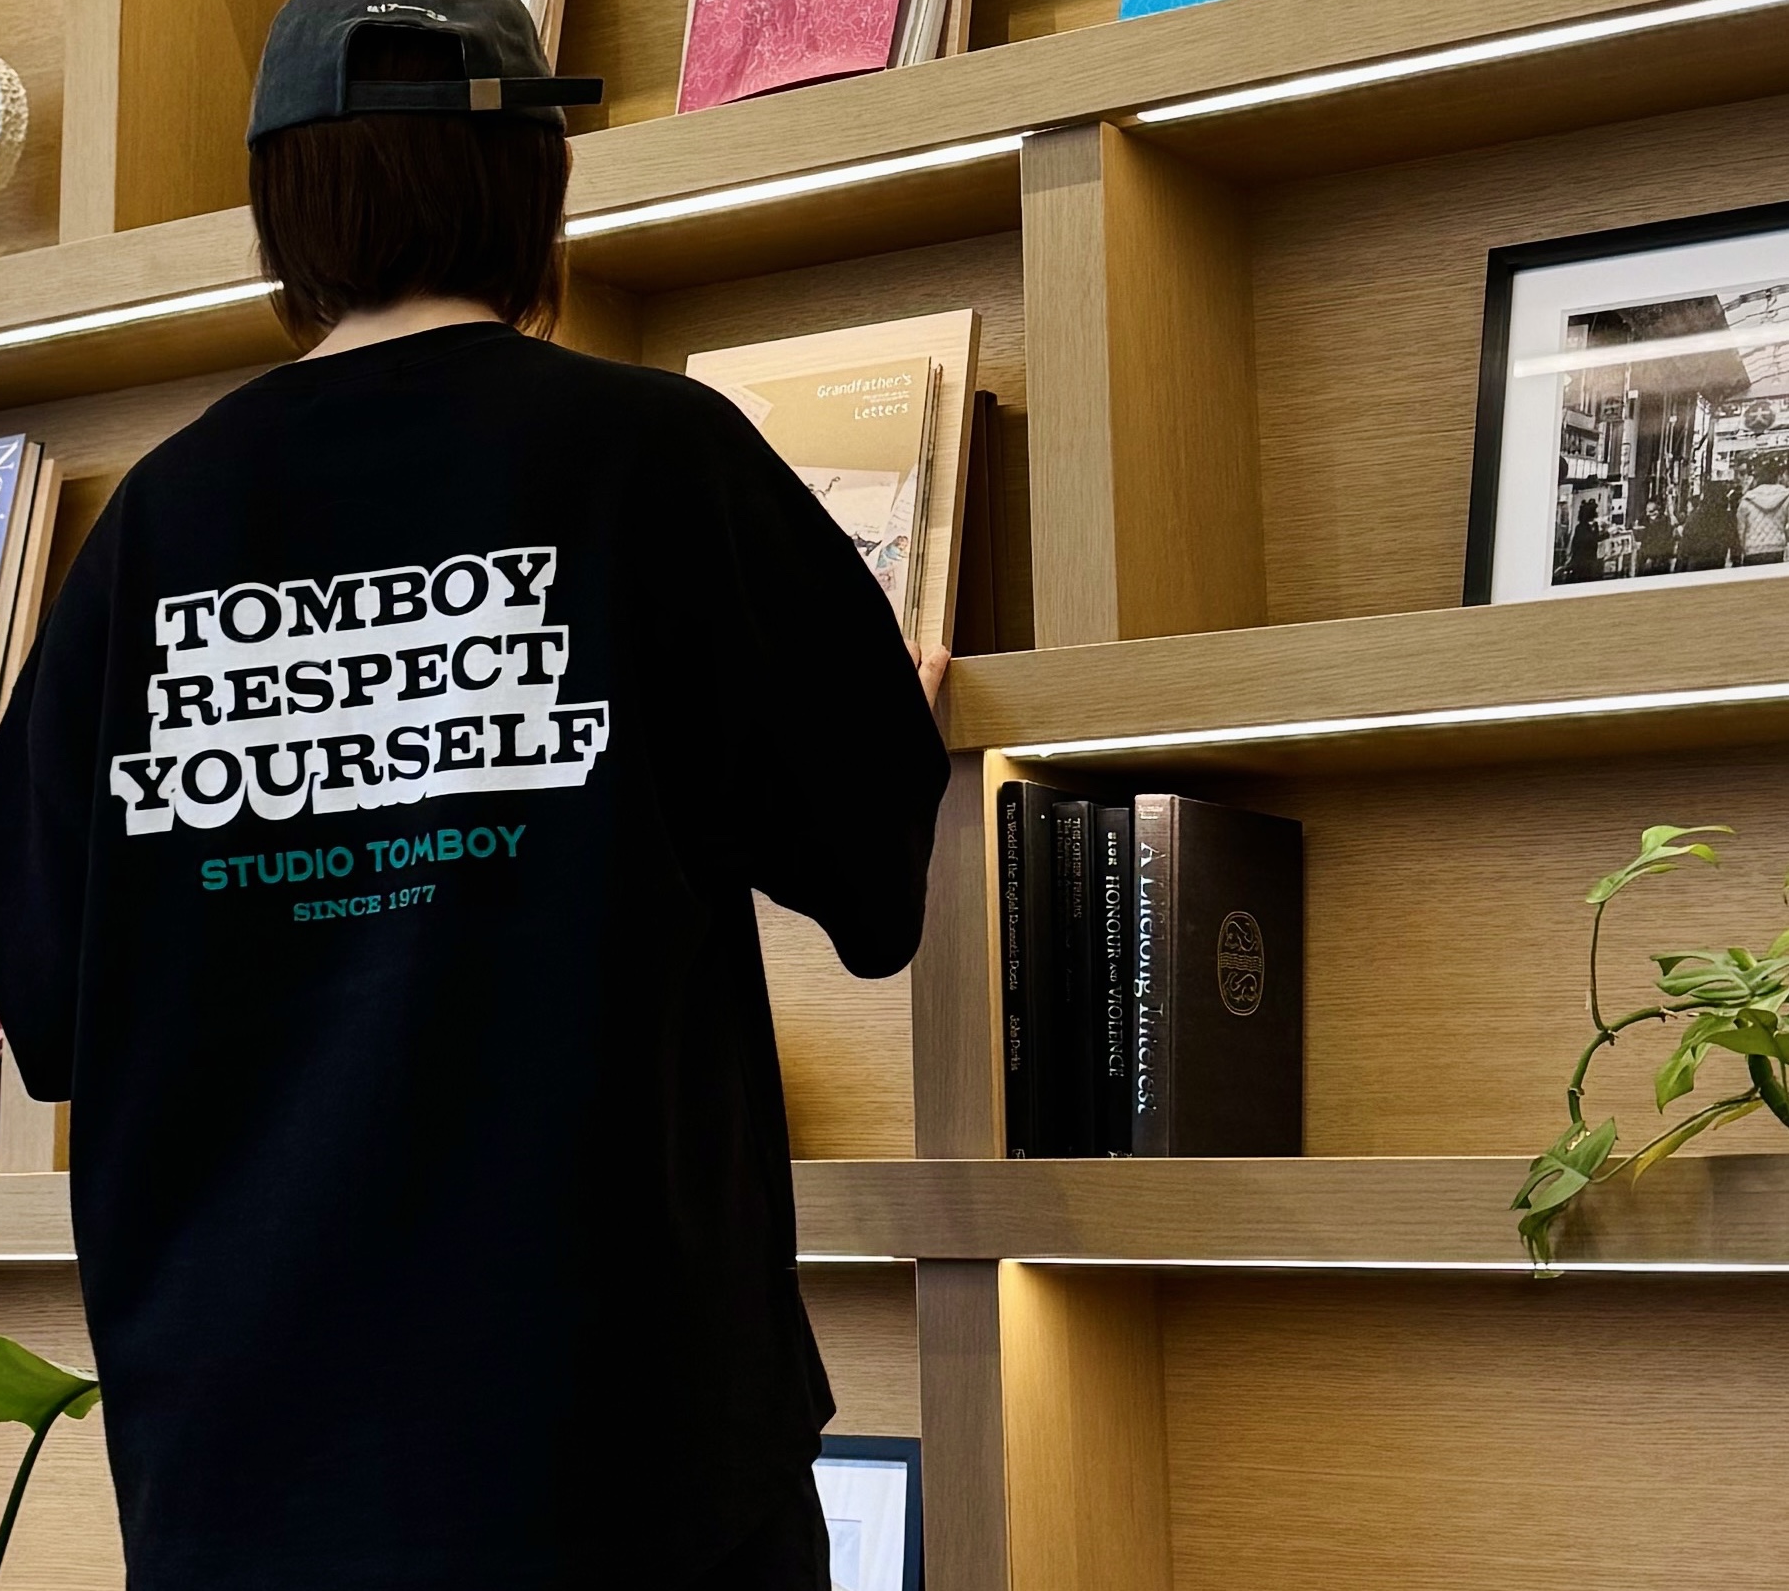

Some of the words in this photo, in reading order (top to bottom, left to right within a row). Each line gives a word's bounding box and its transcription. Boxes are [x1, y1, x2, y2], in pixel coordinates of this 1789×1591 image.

[816, 373, 913, 399] Grandfather's
[853, 402, 909, 420] Letters
[164, 552, 552, 651] TOMBOY
[157, 631, 564, 730] RESPECT
[119, 708, 606, 811] YOURSELF
[1006, 802, 1017, 820] The
[201, 846, 354, 891] STUDIO
[366, 825, 527, 873] TOMBOY
[1008, 863, 1018, 879] the
[1107, 832, 1118, 866] BLOK
[1139, 842, 1167, 868] A
[293, 894, 382, 922] SINCE
[388, 885, 436, 913] 1977
[1105, 875, 1122, 958] HONOUR
[1133, 875, 1166, 998] Lifelong
[1107, 986, 1125, 1078] VIOLENCE
[1137, 1003, 1166, 1114] Interest
